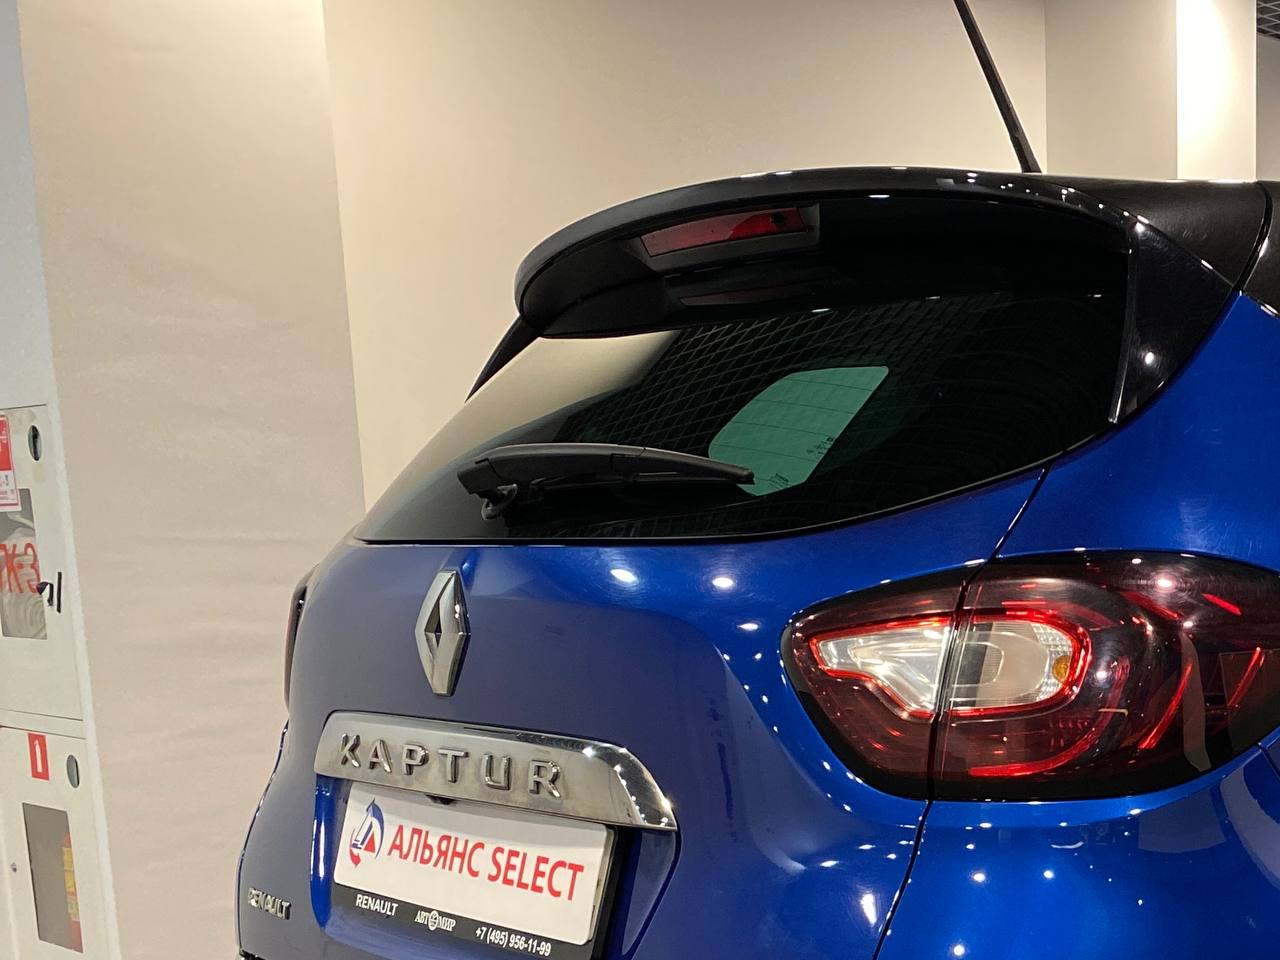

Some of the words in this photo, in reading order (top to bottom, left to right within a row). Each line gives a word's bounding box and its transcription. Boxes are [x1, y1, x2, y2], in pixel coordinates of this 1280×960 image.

[338, 733, 563, 798] KAPTUR
[387, 824, 485, 878] АЛЬЯНС
[487, 846, 585, 901] SELECT
[247, 887, 291, 920] RENAULT
[355, 893, 398, 916] RENAULT
[475, 926, 487, 940] +7
[486, 928, 508, 948] (495)
[508, 934, 552, 957] 956-11-99
